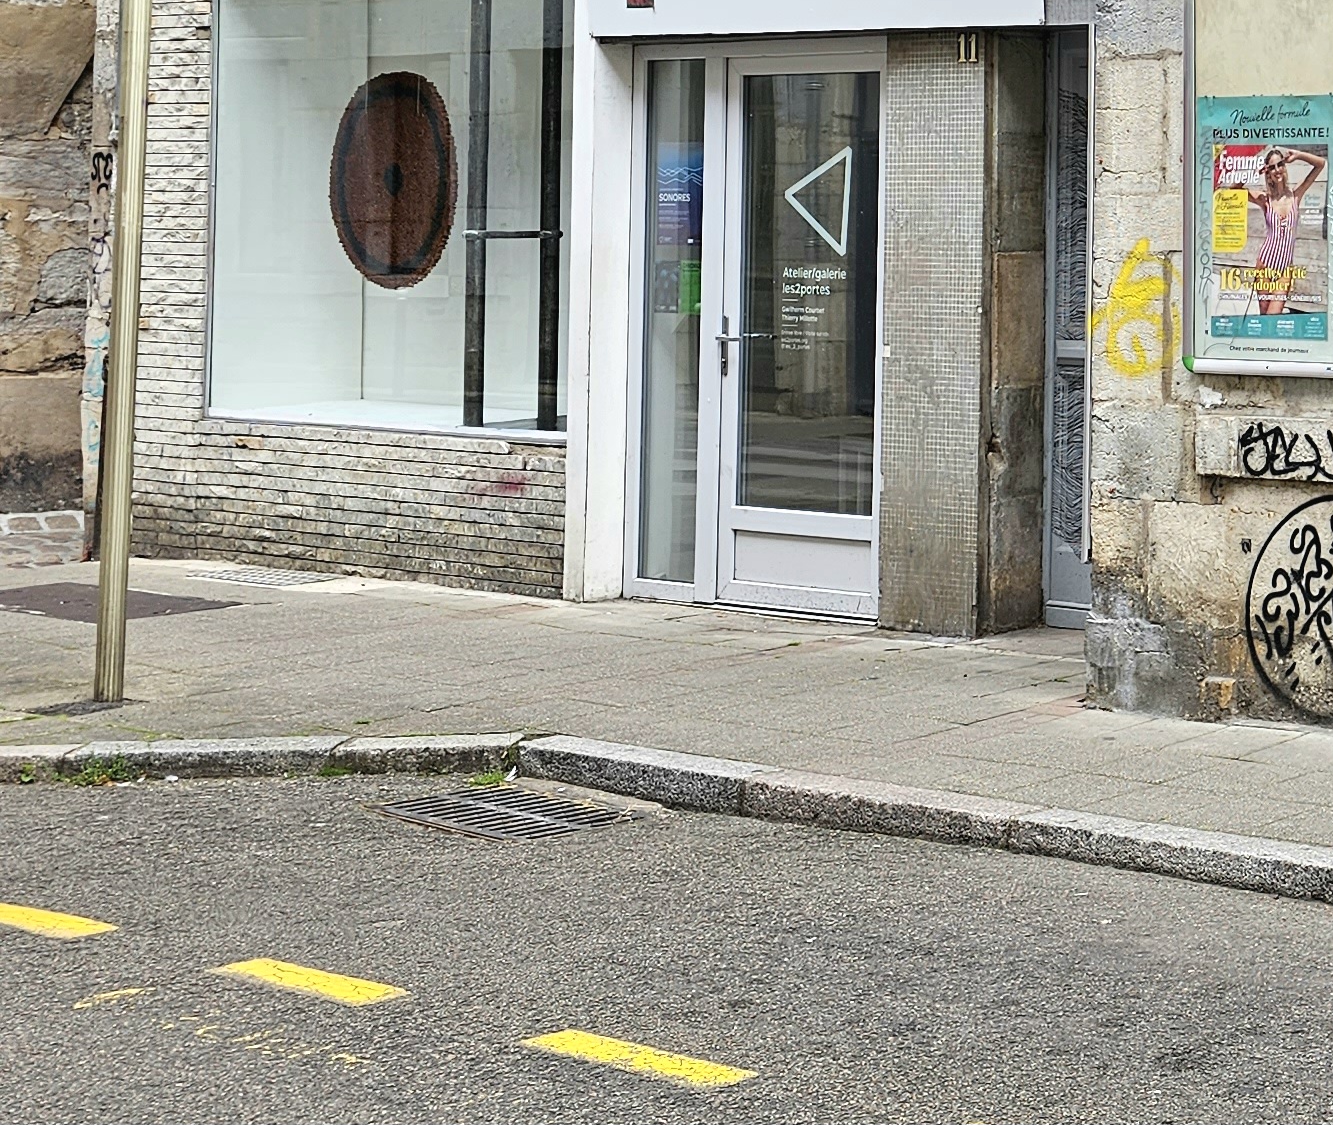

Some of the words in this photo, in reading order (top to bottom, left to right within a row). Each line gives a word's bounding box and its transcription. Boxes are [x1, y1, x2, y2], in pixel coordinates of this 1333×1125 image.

[957, 33, 978, 63] 11
[1230, 105, 1275, 126] Nouvelle
[1276, 101, 1311, 124] formule
[1213, 128, 1240, 139] PLUS
[1219, 149, 1266, 171] Femme
[1218, 169, 1260, 185] Actuelle
[658, 193, 691, 202] SONORES
[782, 266, 847, 282] Atelier/galerie
[1219, 267, 1242, 291] 16
[1243, 267, 1281, 281] recettes
[1283, 265, 1307, 279] d'été
[782, 282, 831, 297] les2portes
